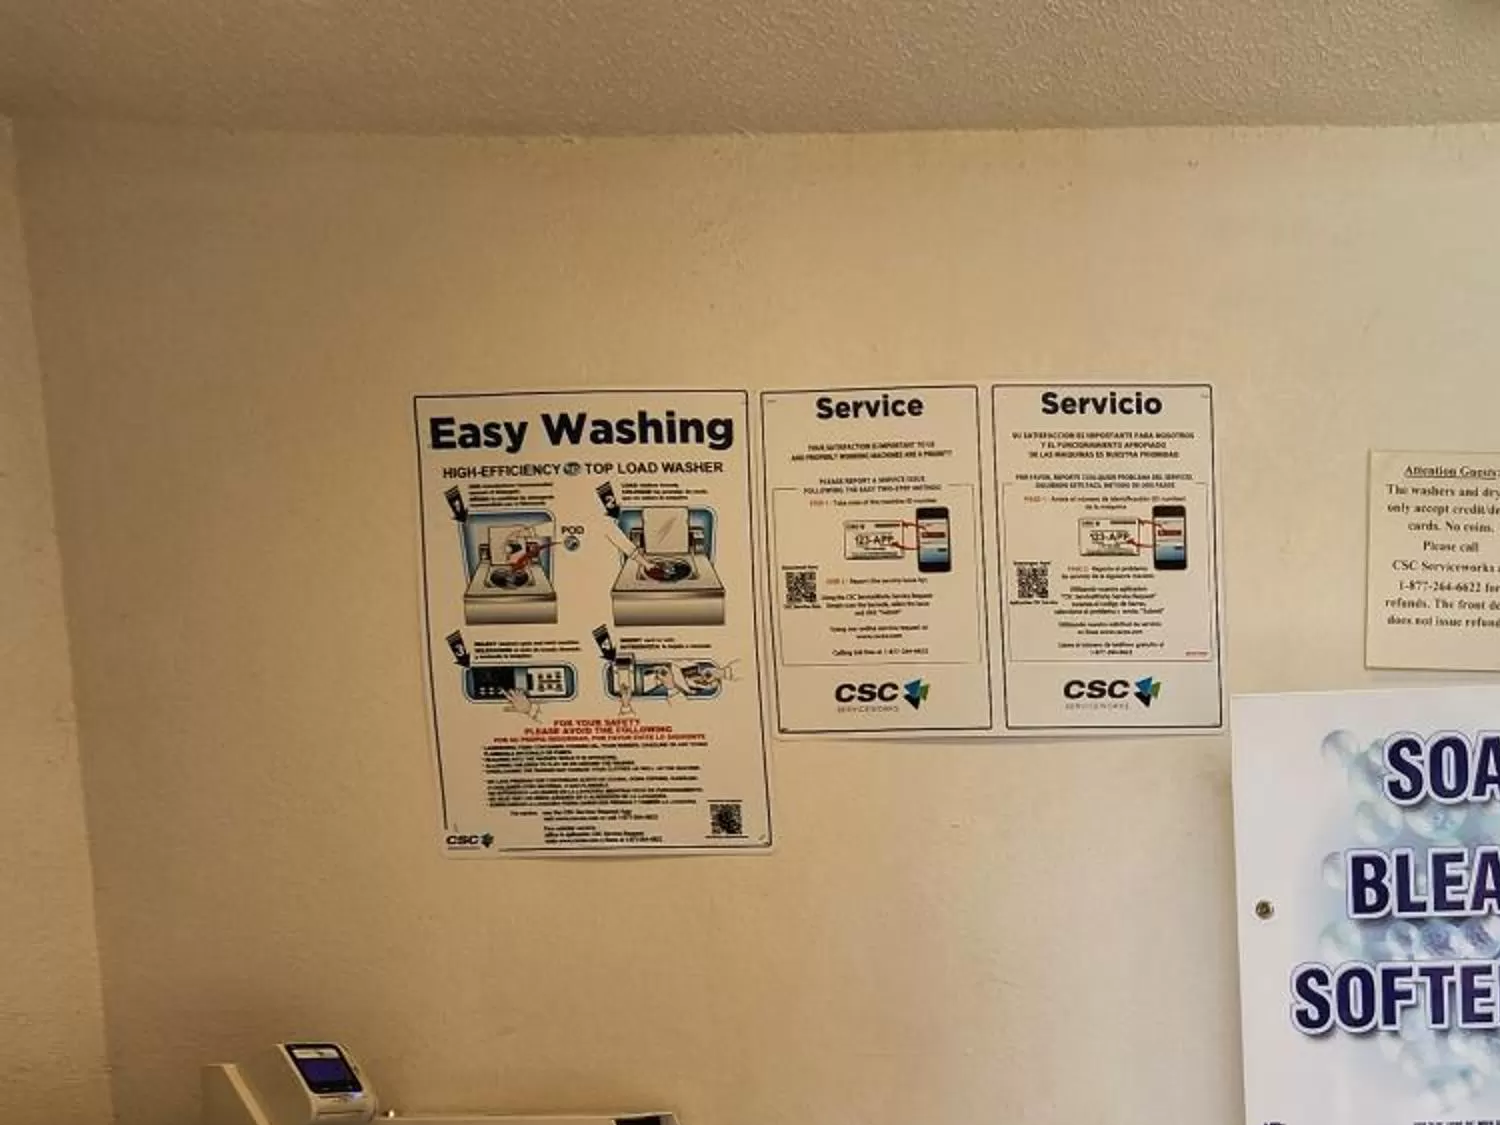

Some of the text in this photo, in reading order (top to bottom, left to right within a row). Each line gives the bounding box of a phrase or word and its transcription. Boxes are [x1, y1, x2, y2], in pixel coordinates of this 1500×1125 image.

[815, 393, 924, 420] Service
[1041, 391, 1162, 416] Servicio
[430, 410, 734, 453] Easy Washing
[443, 463, 561, 479] HIGH-EFFICIENCY
[585, 463, 613, 474] TOP
[618, 462, 658, 474] LOAD
[661, 461, 723, 473] WASHER
[1405, 465, 1500, 479] Attention Guests:
[1386, 483, 1408, 495] The
[1411, 485, 1455, 497] washers
[1459, 487, 1479, 497] and
[1387, 502, 1409, 516] only
[1413, 504, 1449, 516] accept
[1407, 520, 1495, 533] cards. No coins.
[1423, 541, 1479, 553] Please call
[1391, 559, 1418, 571] CSC
[1421, 560, 1494, 573] Serviceworks
[1385, 597, 1431, 609] refunds.
[1435, 599, 1453, 609] The
[1457, 599, 1485, 610] front
[1387, 615, 1411, 625] does
[1415, 617, 1432, 627] not
[1435, 616, 1462, 627] issue
[456, 643, 465, 656] 3
[835, 682, 899, 703] CSC
[1063, 679, 1130, 699] CSC
[446, 835, 478, 845] CSC
